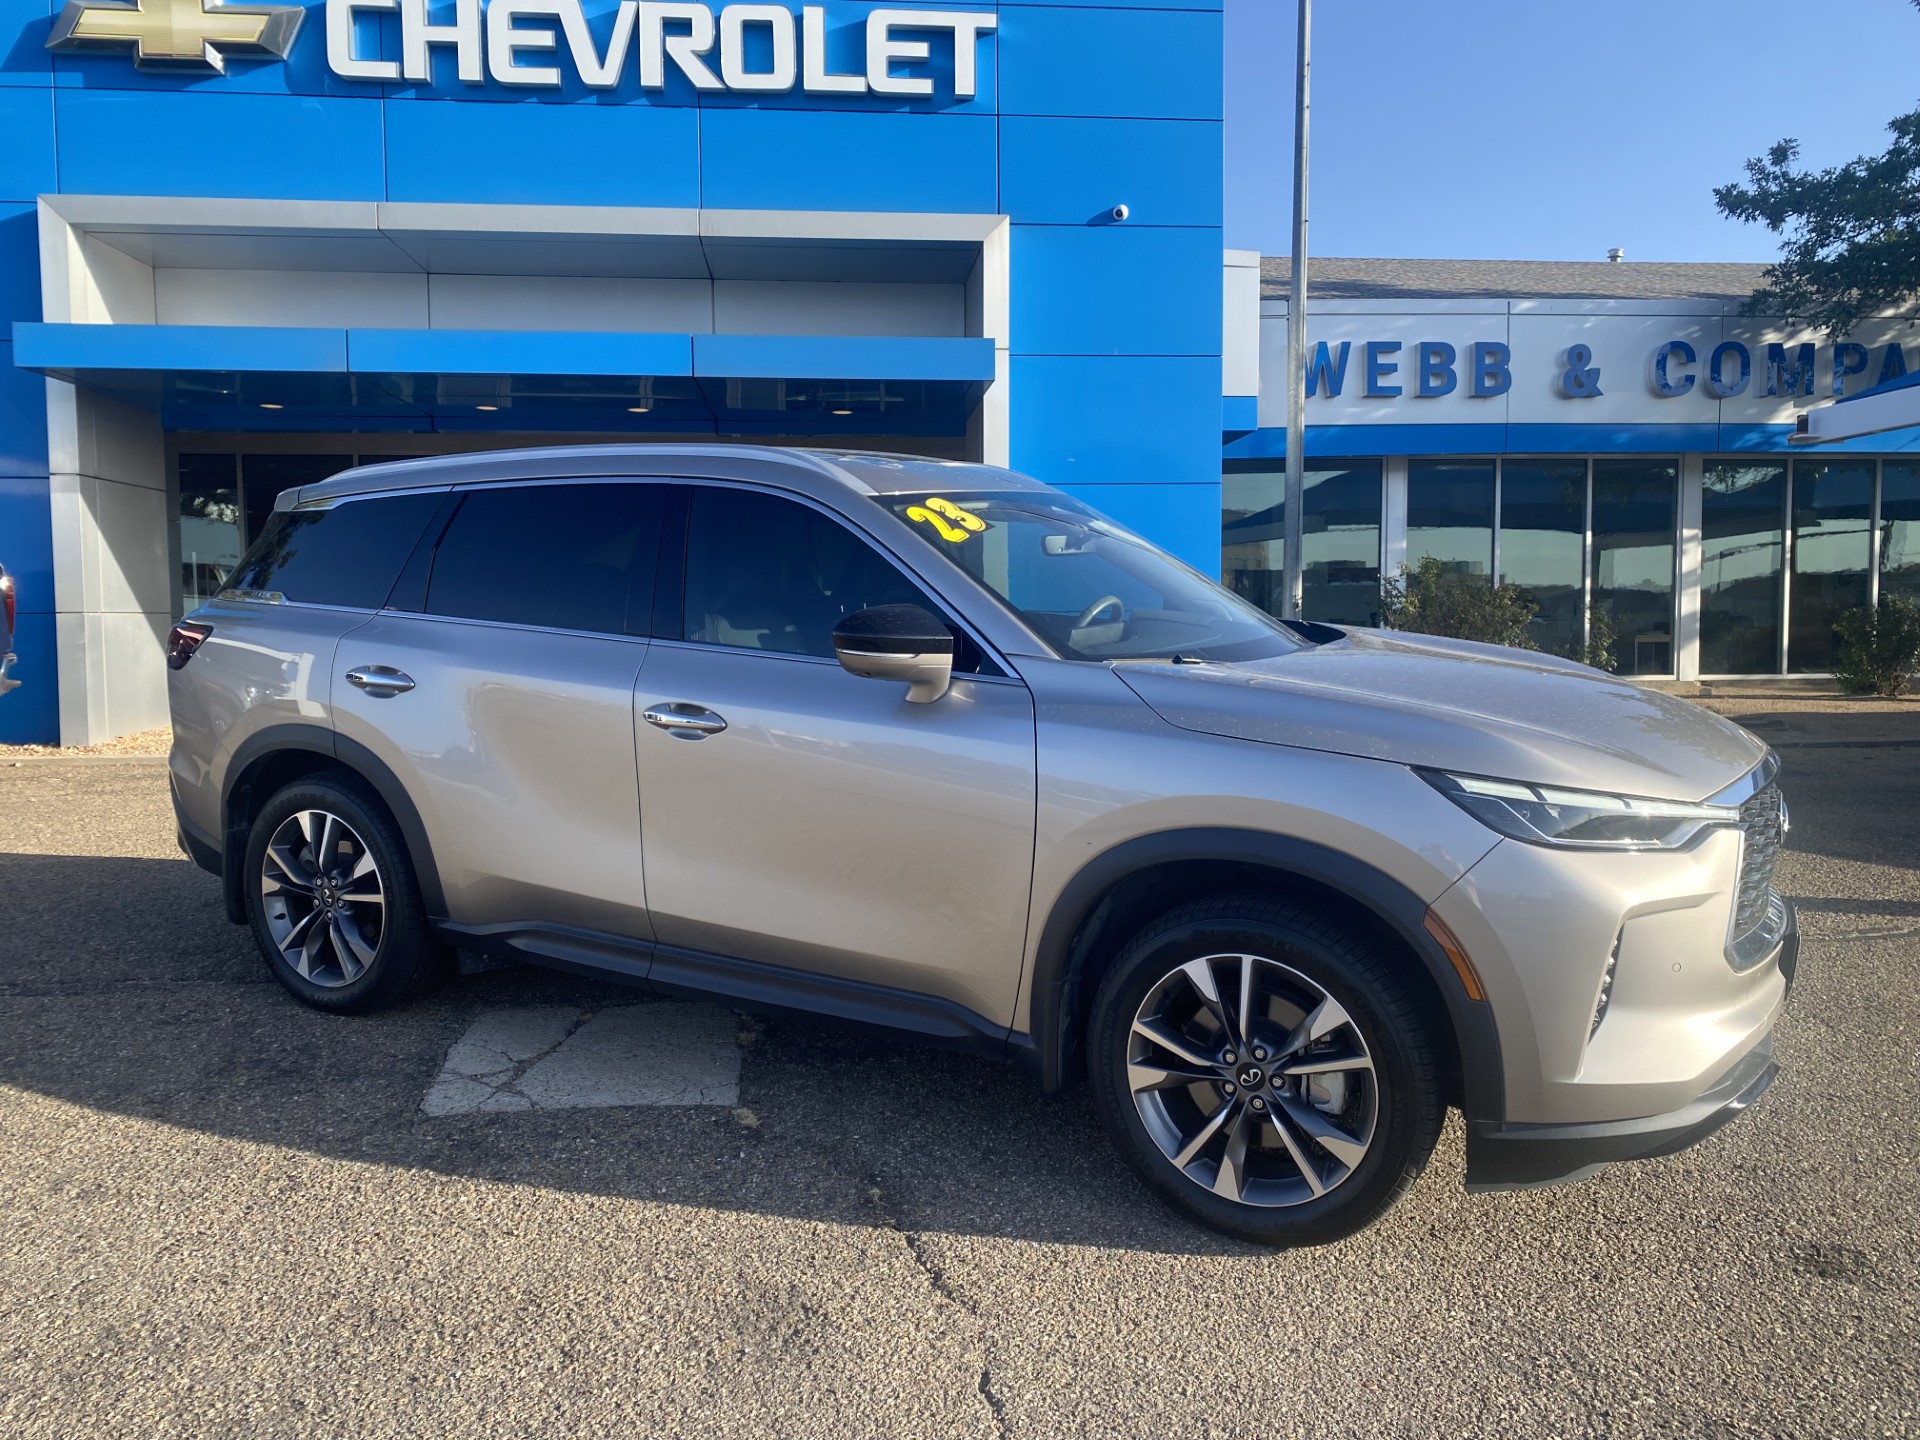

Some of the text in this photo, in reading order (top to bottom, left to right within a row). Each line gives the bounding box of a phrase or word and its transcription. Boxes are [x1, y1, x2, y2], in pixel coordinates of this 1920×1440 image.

[325, 0, 998, 99] CHEVROLET
[1304, 341, 1513, 398] WEBB
[1557, 343, 1603, 399] &
[906, 497, 987, 543] 23
